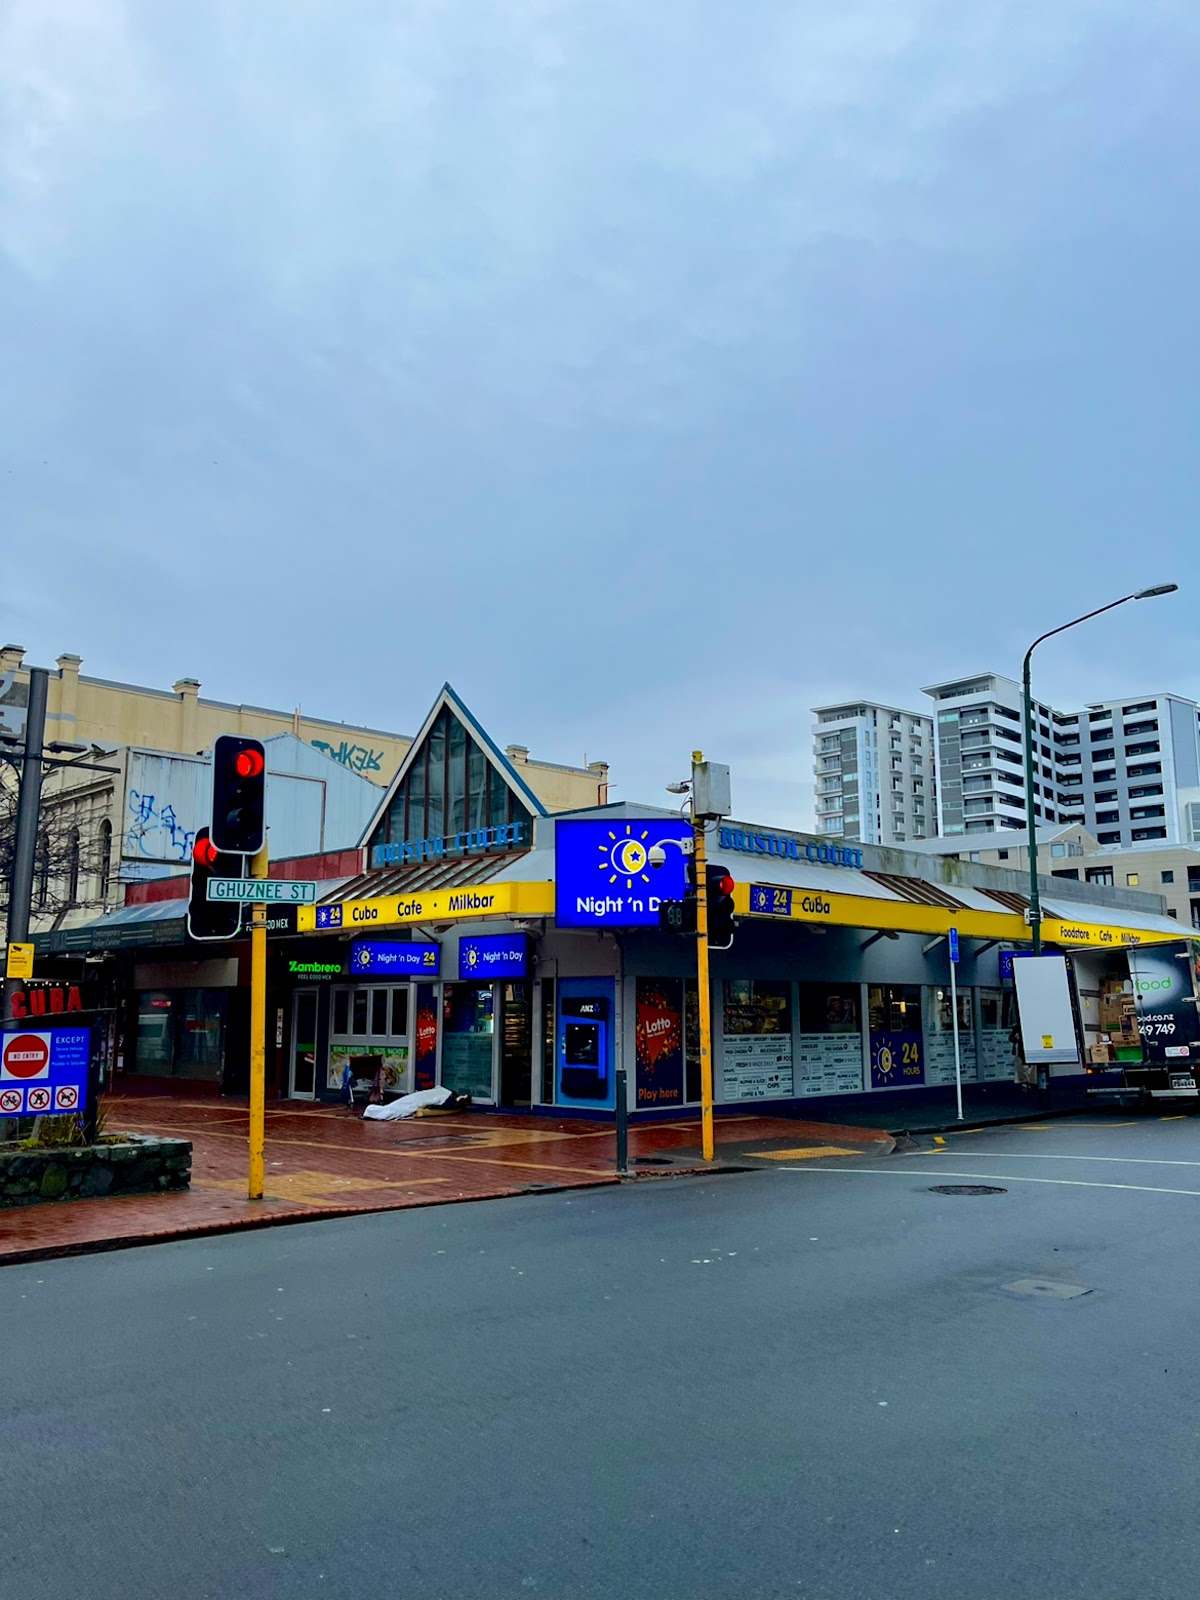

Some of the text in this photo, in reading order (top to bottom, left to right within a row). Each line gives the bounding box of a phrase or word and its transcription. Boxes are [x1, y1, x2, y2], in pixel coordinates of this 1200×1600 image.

[719, 827, 864, 869] BRISTOL COURT
[216, 882, 308, 899] GHUZNEE ST
[773, 890, 787, 906] 24
[353, 893, 495, 921] Cuba Cafe Milkbar
[576, 896, 623, 917] Night
[802, 896, 831, 914] Cuba
[1060, 926, 1141, 944] Foodstore Cafe Milkbar
[377, 953, 397, 964] Night
[407, 954, 421, 965] Day
[423, 951, 435, 962] 24
[483, 951, 501, 963] Night
[510, 951, 524, 962] Day
[289, 960, 342, 973] Zambrero
[11, 986, 82, 1018] CUBA
[580, 1005, 594, 1013] ANZ
[646, 1017, 671, 1034] Lotto
[1155, 1023, 1176, 1035] 749
[56, 1036, 84, 1044] EXCEPT
[902, 1042, 919, 1063] 24
[904, 1066, 921, 1076] HOURS
[639, 1088, 657, 1101] Play
